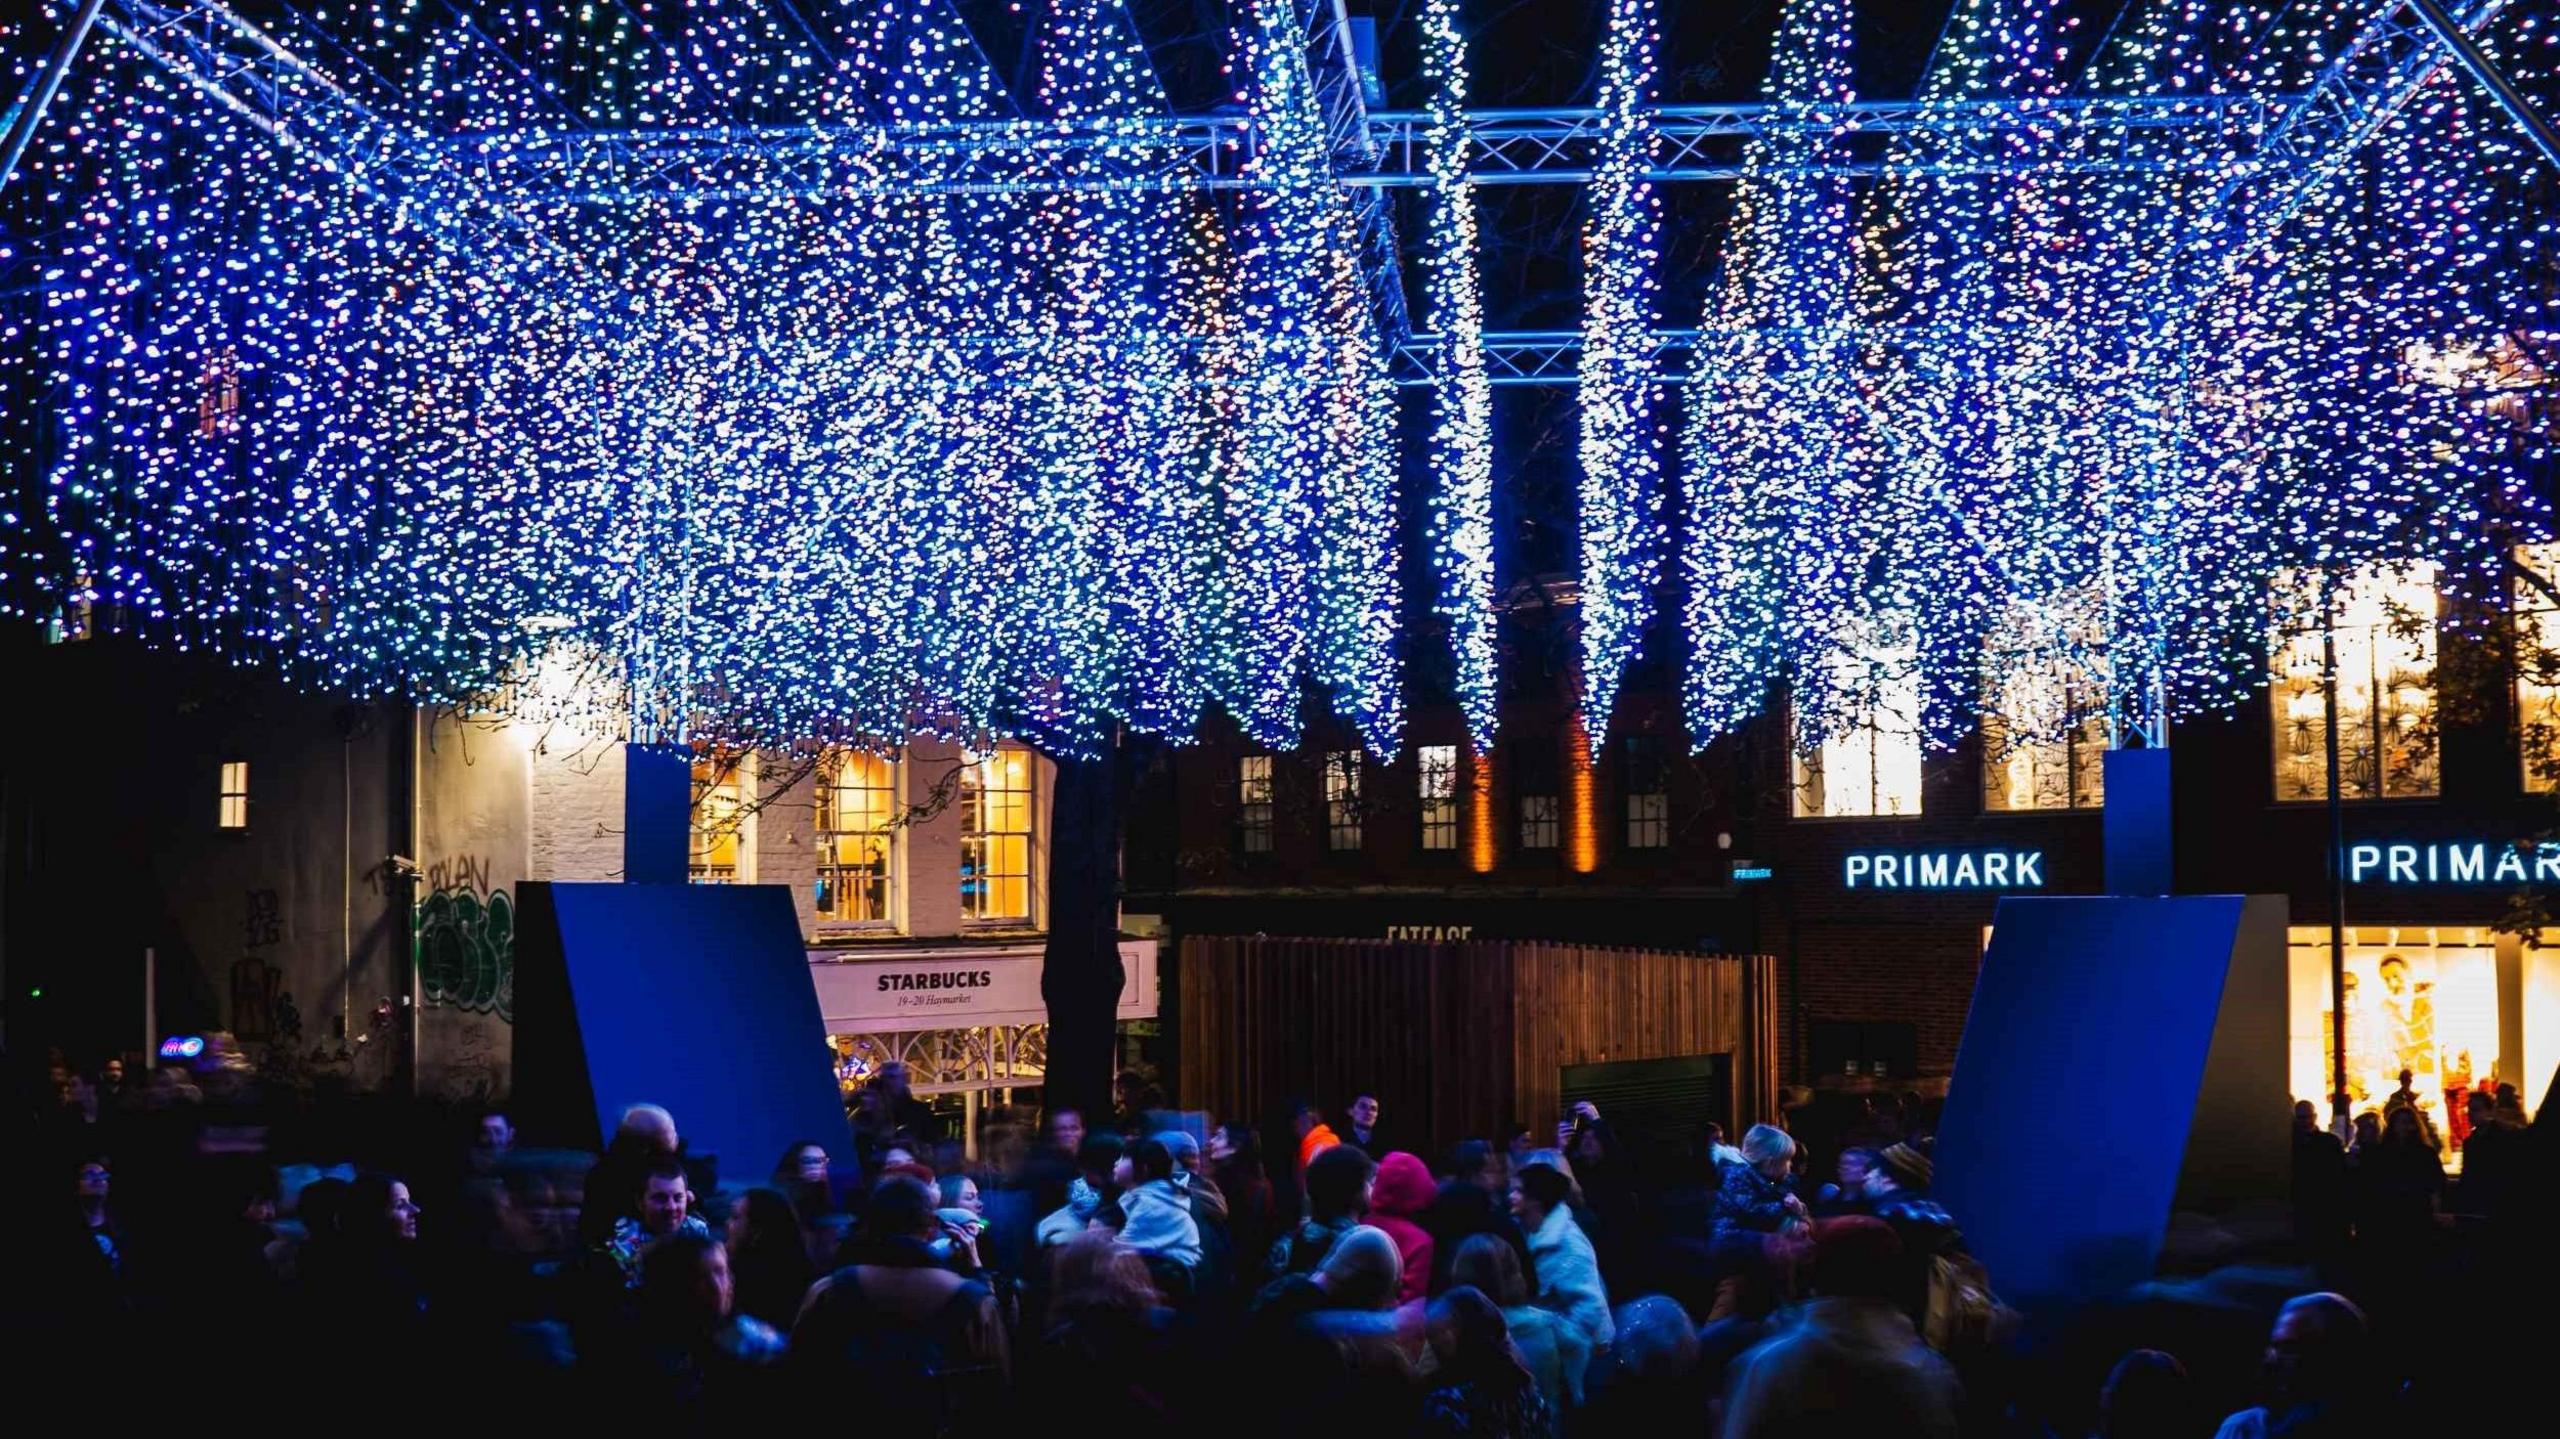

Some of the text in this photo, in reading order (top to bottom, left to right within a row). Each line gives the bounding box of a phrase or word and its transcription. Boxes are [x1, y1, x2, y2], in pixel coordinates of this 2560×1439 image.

[1846, 852, 2043, 887] PRIMARK
[878, 970, 991, 991] STARBUCKS
[926, 993, 971, 1007] Haymarket
